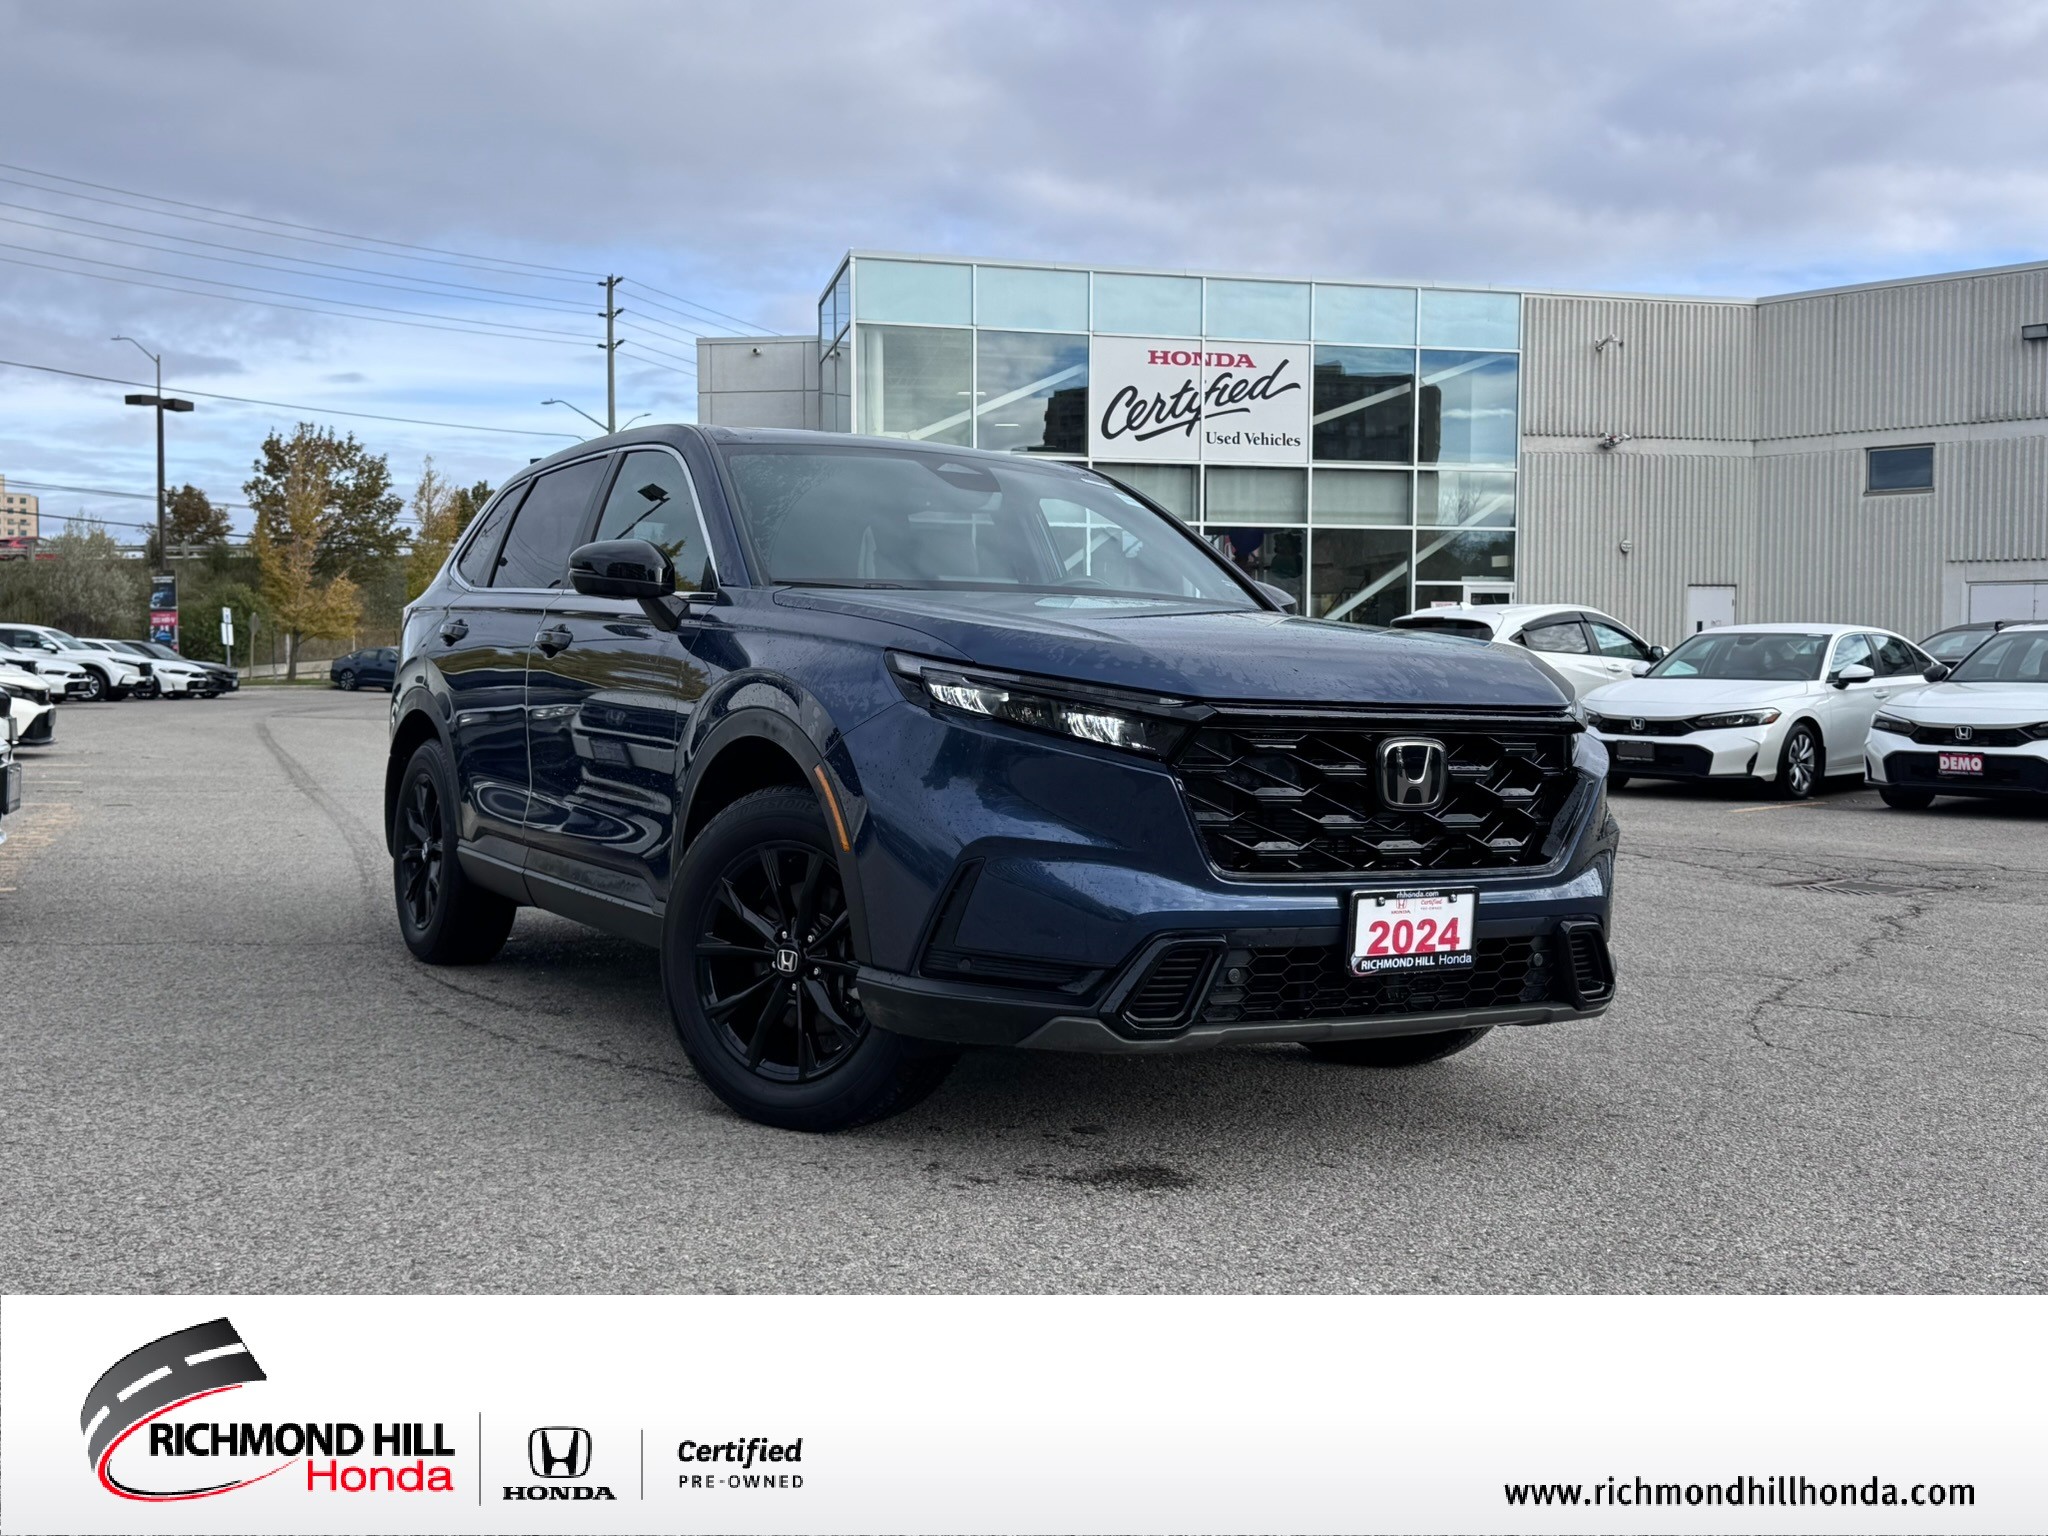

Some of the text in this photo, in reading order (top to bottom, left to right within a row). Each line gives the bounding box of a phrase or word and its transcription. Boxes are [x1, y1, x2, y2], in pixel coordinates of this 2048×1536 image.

[1147, 350, 1256, 368] HONDA
[1101, 358, 1301, 440] Certified
[1206, 431, 1300, 446] Used Vehicles
[1939, 756, 1982, 771] DEMO
[1396, 891, 1439, 899] rhhonda.com
[1367, 917, 1460, 955] 2024
[1361, 953, 1472, 970] RICHMOND HILL Honda
